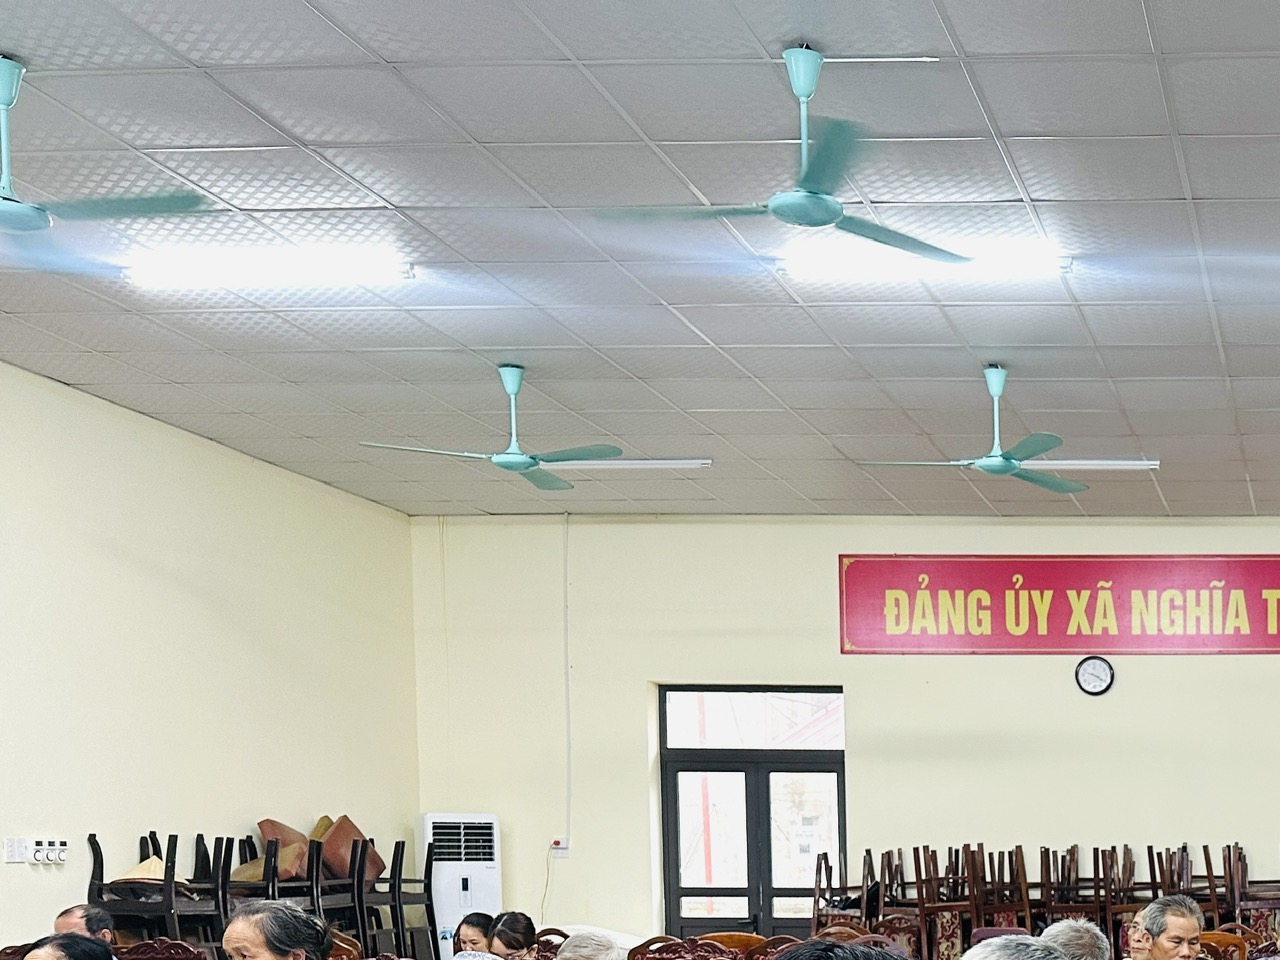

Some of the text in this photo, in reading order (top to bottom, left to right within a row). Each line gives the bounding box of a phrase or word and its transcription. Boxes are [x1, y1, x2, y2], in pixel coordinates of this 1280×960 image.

[884, 574, 991, 636] ĐẢNG
[1005, 575, 1054, 635] ỦY
[1066, 580, 1119, 635] XÃ
[1131, 580, 1251, 635] NGHĨA
